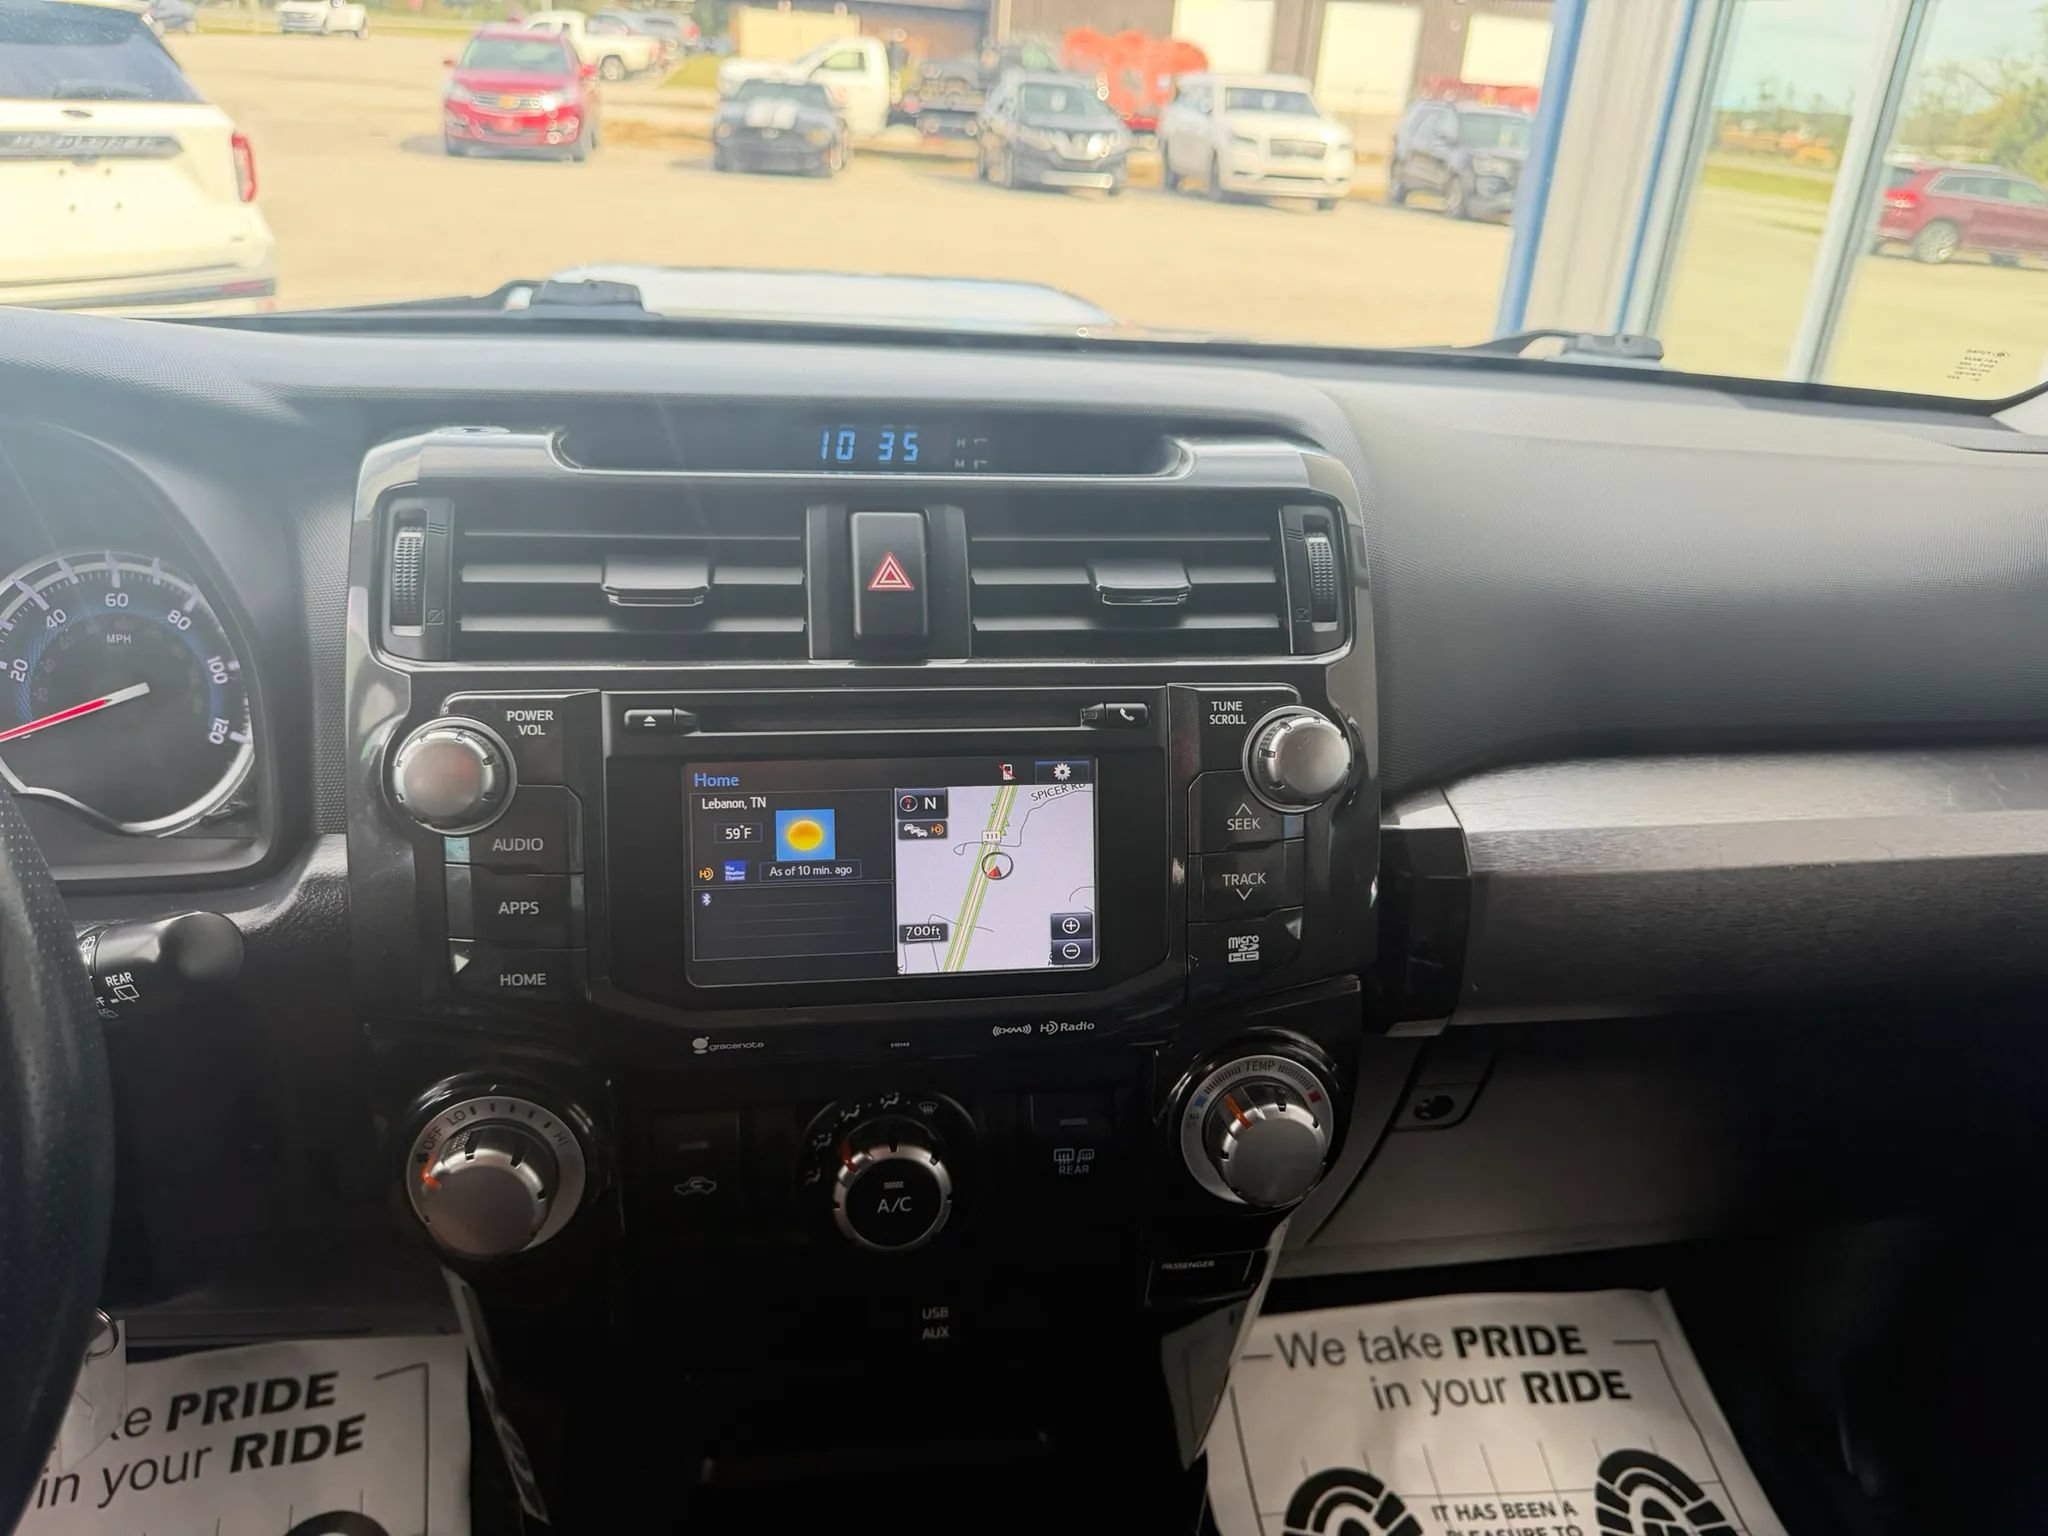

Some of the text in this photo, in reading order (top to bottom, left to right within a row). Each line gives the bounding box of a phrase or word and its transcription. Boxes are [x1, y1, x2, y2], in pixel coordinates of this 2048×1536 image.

[820, 431, 919, 461] 10 35
[105, 593, 129, 607] 60
[46, 608, 67, 629] 40
[167, 609, 191, 631] 80
[106, 635, 131, 644] MPH
[10, 658, 28, 682] 20
[207, 655, 228, 685] 100
[1211, 701, 1243, 712] TUNE
[506, 709, 554, 722] POWER
[1209, 714, 1247, 725] SCROLL
[208, 717, 230, 745] 120
[518, 724, 546, 736] VOL
[693, 773, 740, 788] Home
[1031, 784, 1068, 801] SPICER
[702, 797, 767, 810] Lebanon, TN
[924, 797, 937, 809] N
[1227, 817, 1261, 831] SEEK
[492, 837, 544, 852] AUDIO
[769, 865, 853, 877] As of 10 min. ago
[1222, 872, 1266, 886] TRACK
[498, 902, 540, 915] APPS
[906, 926, 940, 938] 700ft
[105, 972, 133, 987] REAR
[500, 973, 547, 987] HOME
[1060, 1021, 1095, 1031] Radio
[709, 1041, 764, 1051] gracenote
[1245, 1061, 1276, 1072] TEMP
[446, 1110, 466, 1125] LO
[423, 1126, 442, 1149] OFF
[554, 1131, 569, 1147] HI
[1058, 1164, 1089, 1175] REAR
[877, 1196, 912, 1214] A/C
[1162, 1261, 1215, 1270] PASSENGER
[922, 1306, 949, 1319] USB
[921, 1327, 950, 1340] AUX
[1274, 1325, 1587, 1370] We take PRIDE
[1370, 1369, 1632, 1416] in your RIDE
[166, 1371, 338, 1432] PRIDE
[37, 1413, 366, 1508] in your RIDE
[1432, 1500, 1578, 1521] IT HAS BEEN A
